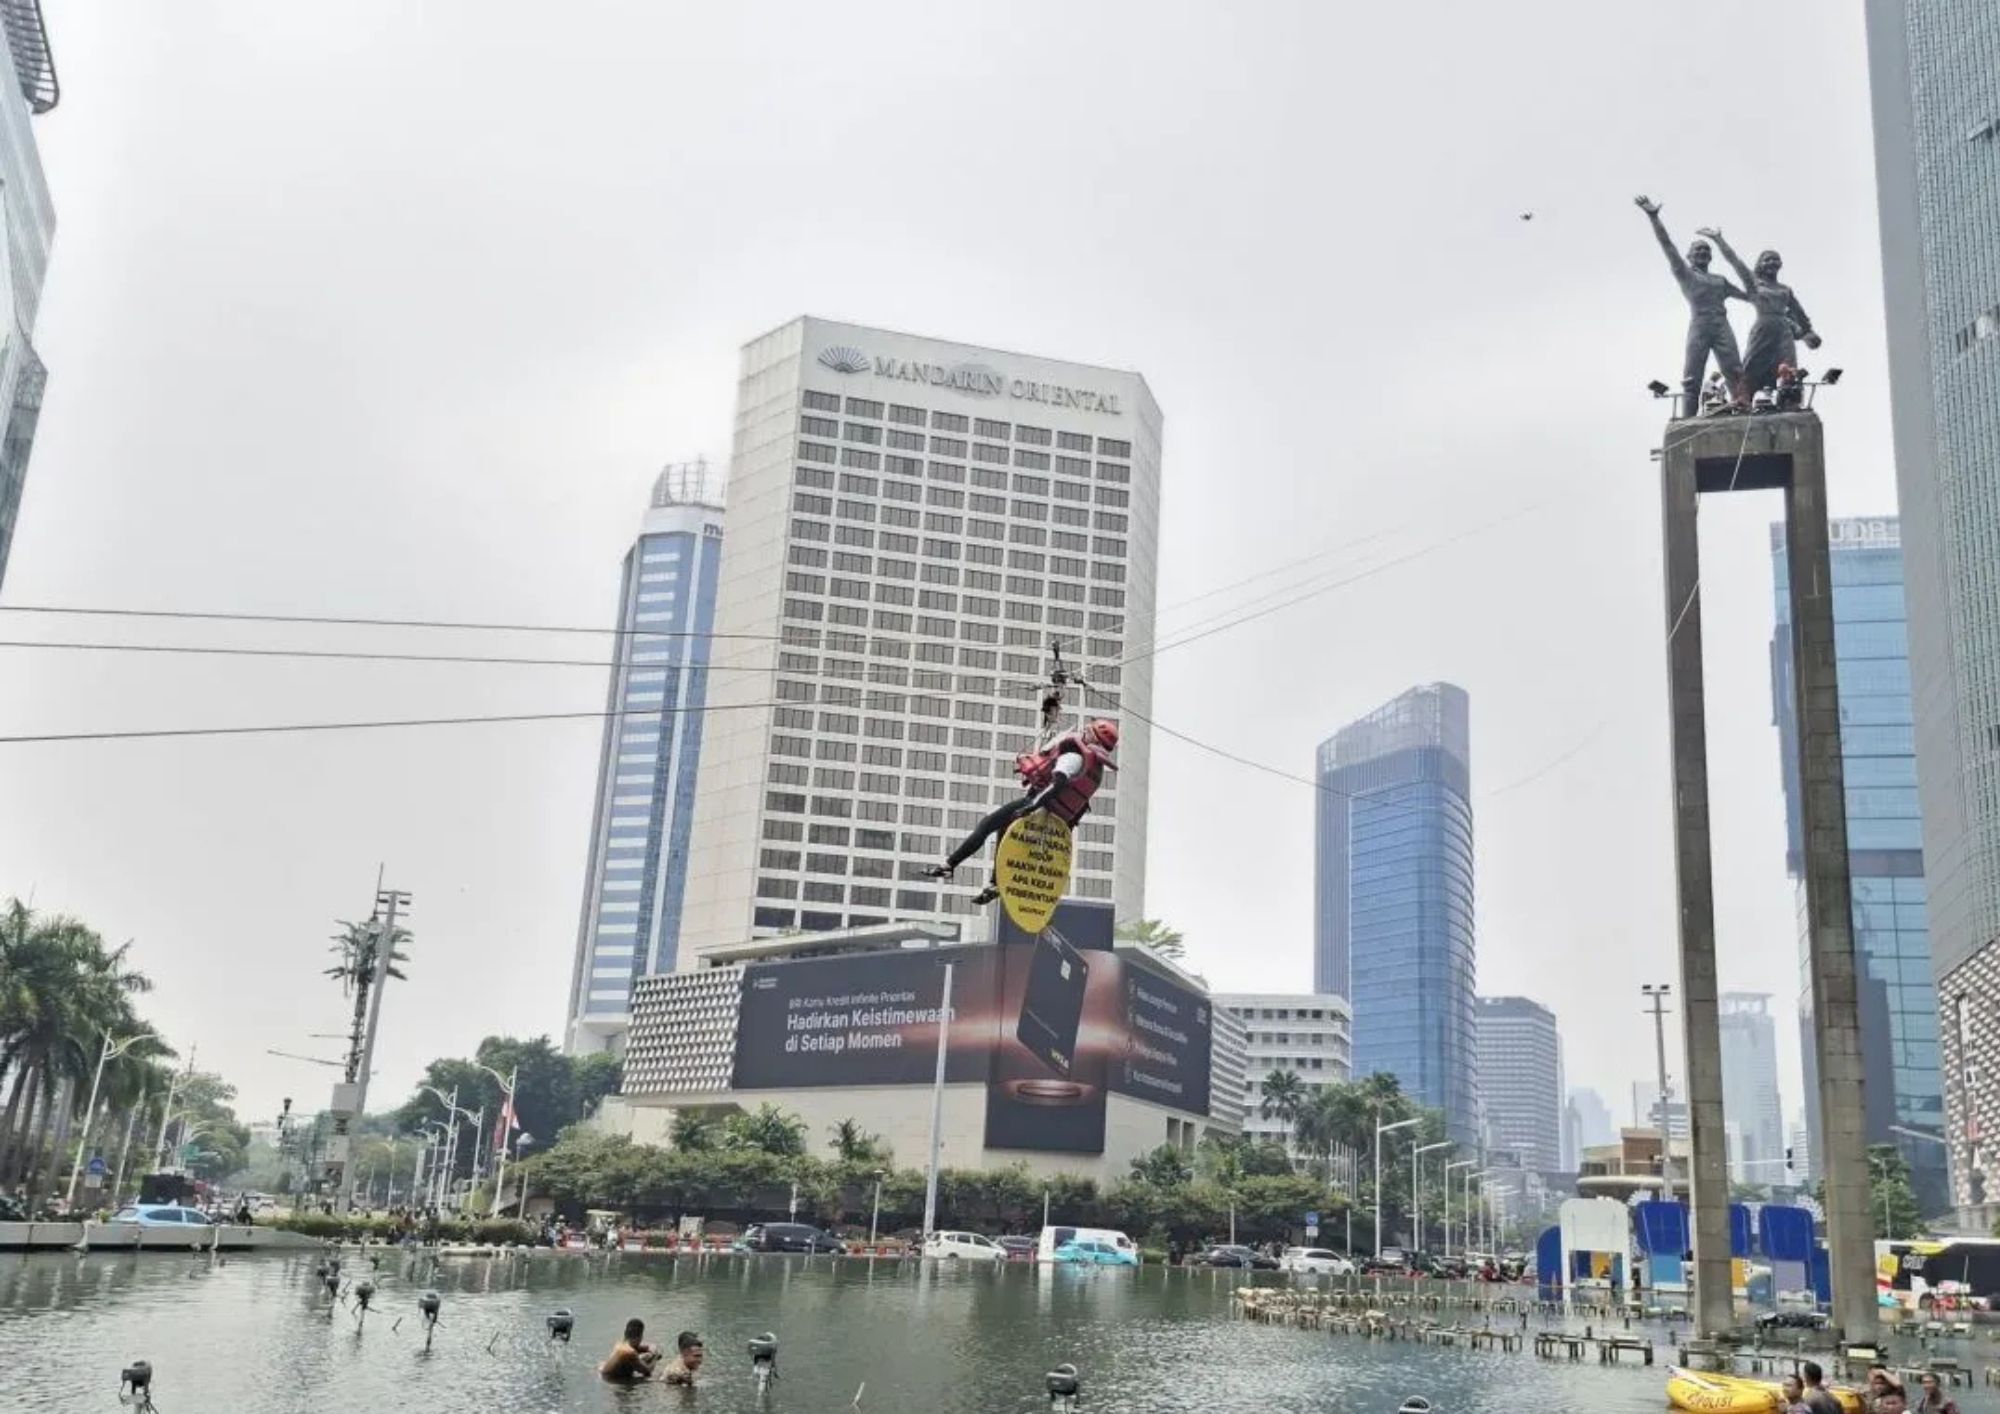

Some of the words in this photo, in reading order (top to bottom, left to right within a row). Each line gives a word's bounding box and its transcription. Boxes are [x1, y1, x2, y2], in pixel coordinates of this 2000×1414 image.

[874, 355, 1003, 395] MANDARIN
[1010, 379, 1122, 415] ORIENTAL
[1006, 859, 1037, 871] MAKIN
[787, 1011, 848, 1030] Hadirkan
[851, 1006, 955, 1027] Keistimewaan
[785, 1035, 798, 1052] di
[800, 1032, 845, 1054] Setiap
[848, 1030, 902, 1049] Momen
